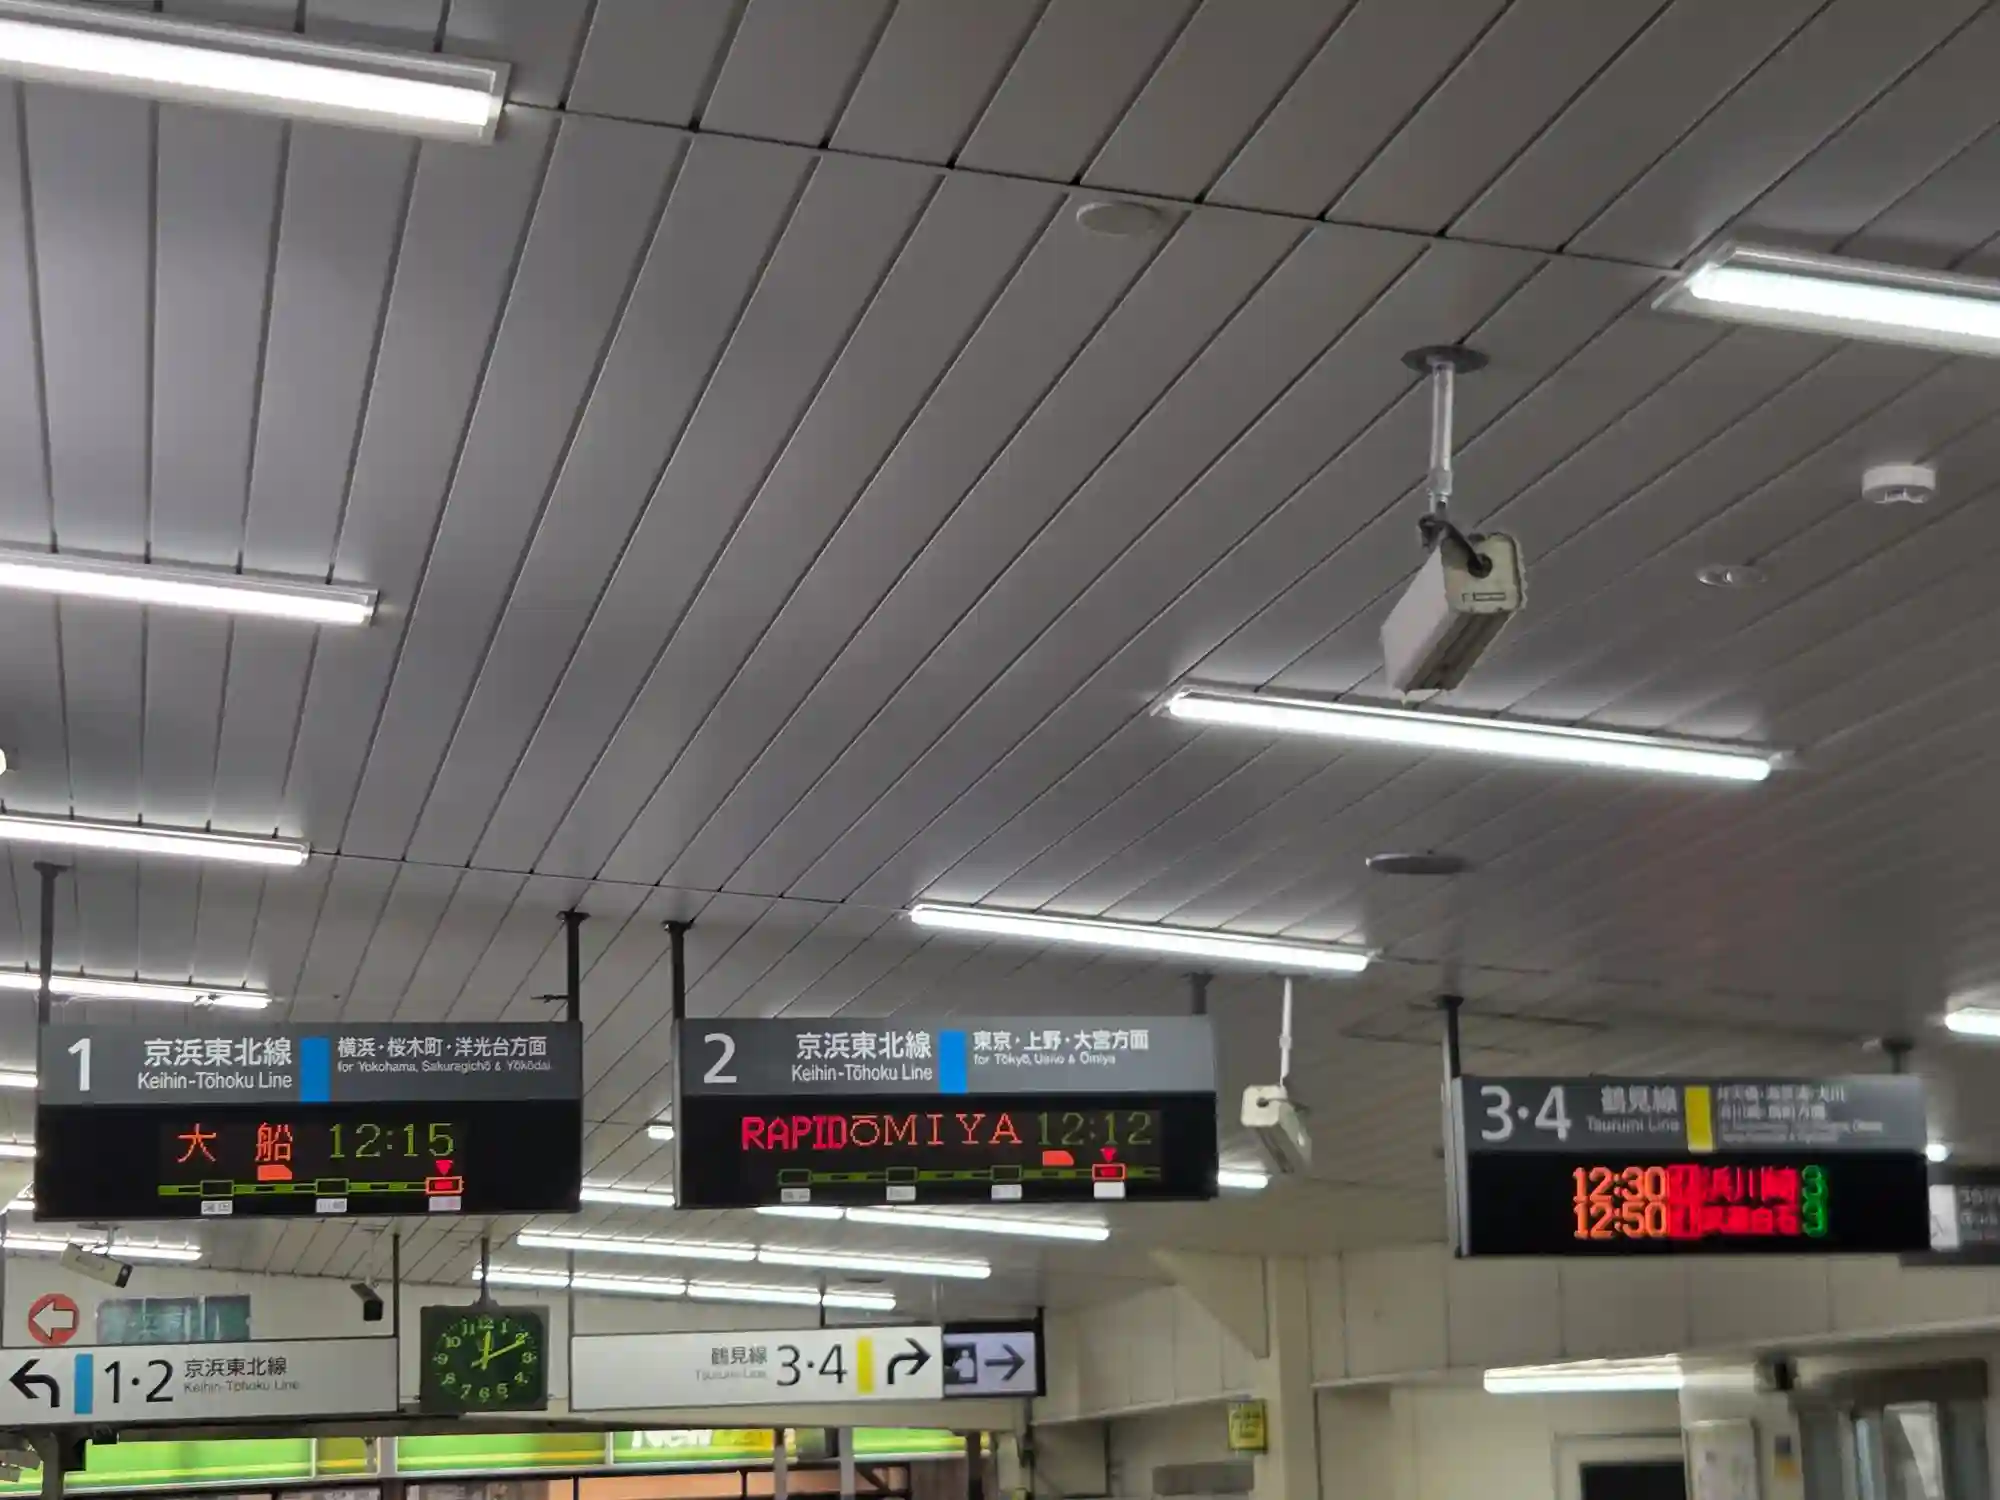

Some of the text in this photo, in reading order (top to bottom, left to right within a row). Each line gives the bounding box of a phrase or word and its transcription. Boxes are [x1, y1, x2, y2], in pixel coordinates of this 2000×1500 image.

[144, 1036, 293, 1067] 京浜東北線
[703, 1033, 738, 1084] 2
[796, 1031, 933, 1060] 京浜東北線
[974, 1053, 990, 1066] for
[67, 1037, 92, 1092] 1
[337, 1060, 354, 1073] for
[358, 1060, 419, 1073] Yokohama,
[494, 1060, 502, 1072] &
[791, 1062, 934, 1084] Keihin-Tōhoku Line
[138, 1071, 294, 1091] Keihin-Tōhoku Line
[329, 1122, 454, 1159] 12:15
[741, 1114, 847, 1151] RAPID
[1037, 1111, 1153, 1147] 12:12
[1573, 1166, 1667, 1202] 12:30
[1573, 1202, 1667, 1239] 12:50
[446, 1335, 462, 1348] 10
[184, 1356, 287, 1379] 京浜東北線
[479, 1386, 491, 1399] 6
